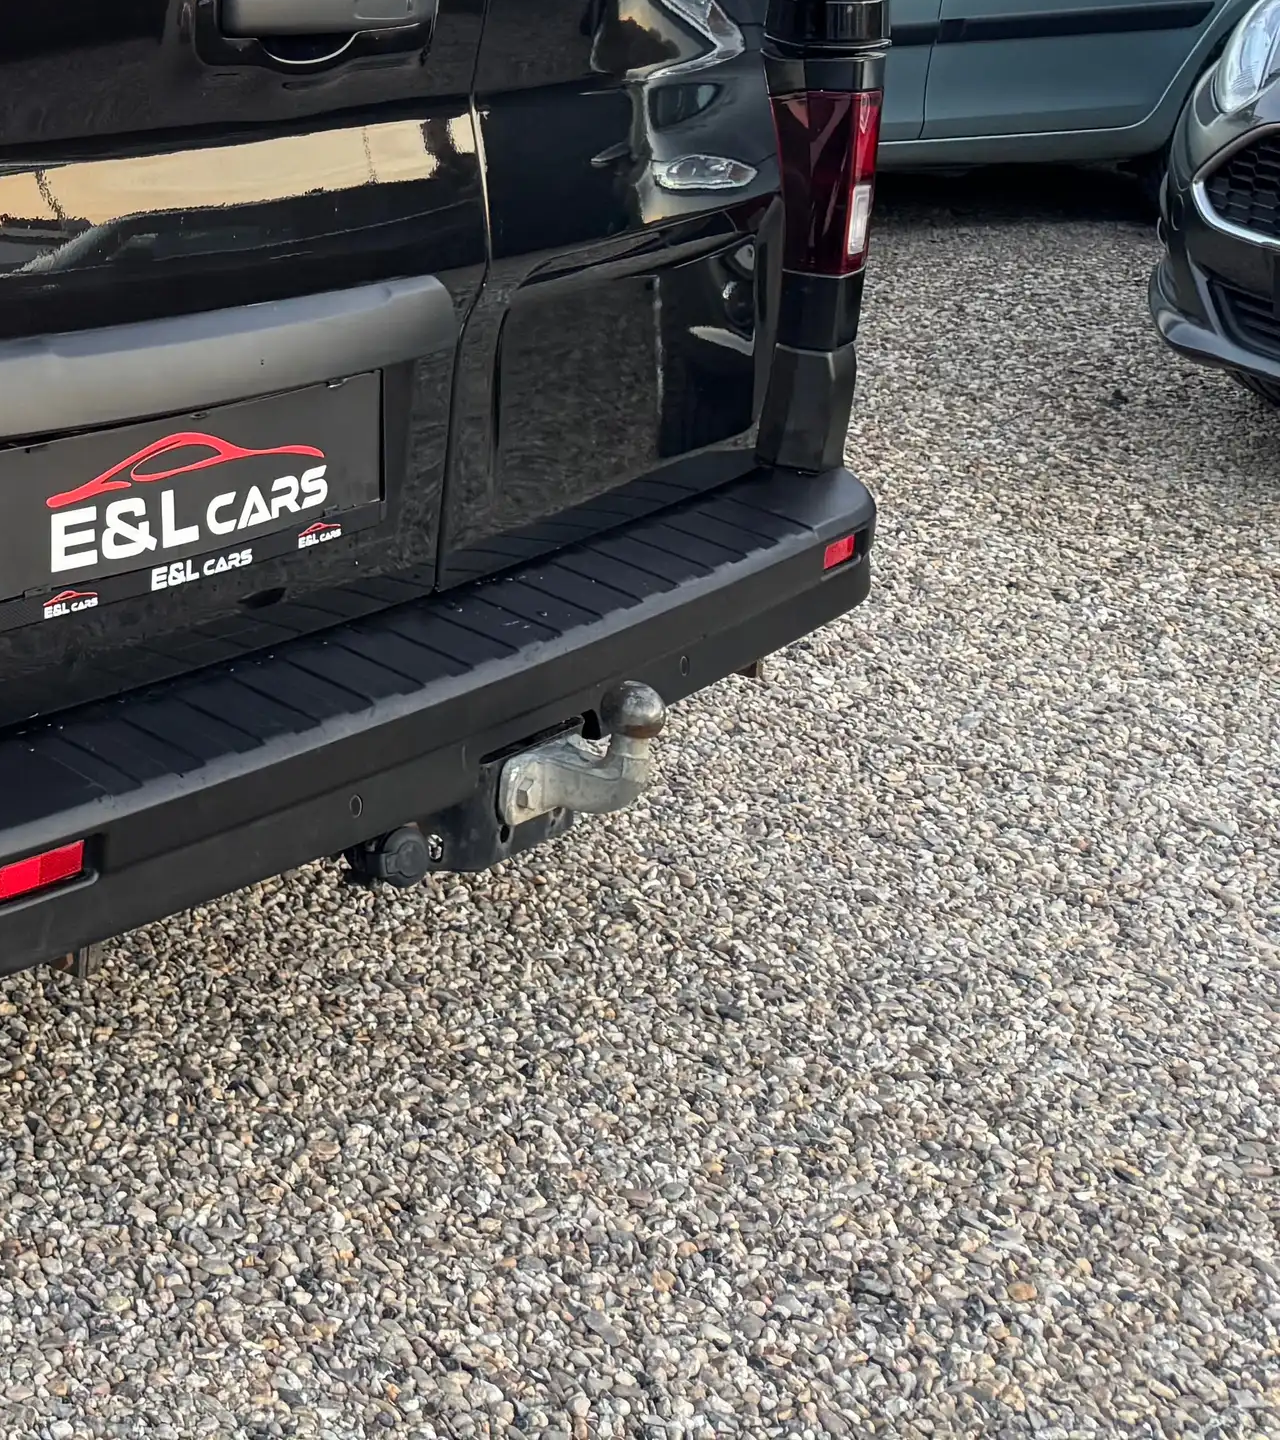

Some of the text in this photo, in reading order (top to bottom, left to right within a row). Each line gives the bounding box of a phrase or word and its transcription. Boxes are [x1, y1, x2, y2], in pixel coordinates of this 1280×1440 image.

[50, 464, 328, 573] E&L CARS
[298, 528, 342, 549] E&L CARS
[150, 548, 253, 592] E&L CARS
[43, 596, 99, 620] E&L CARS
